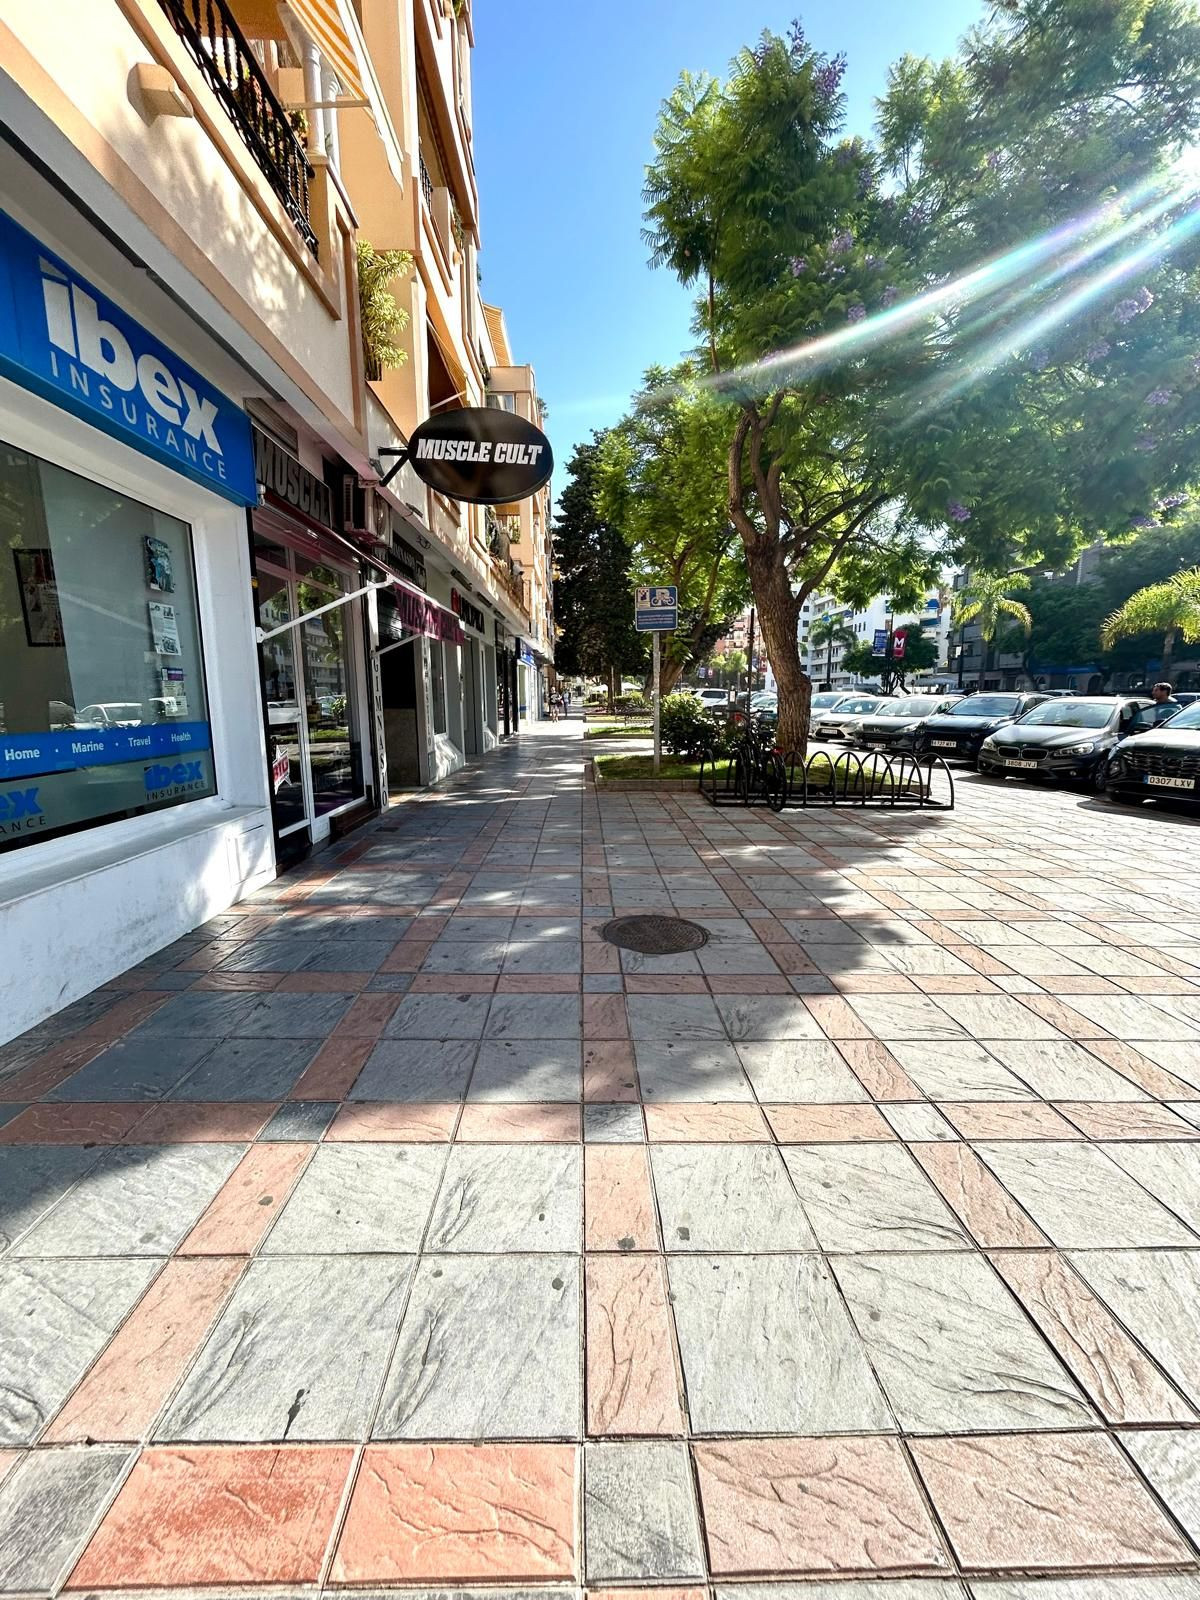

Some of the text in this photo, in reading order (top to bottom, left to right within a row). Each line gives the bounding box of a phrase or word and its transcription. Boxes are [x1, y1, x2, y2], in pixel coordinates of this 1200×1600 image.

[39, 255, 223, 457] ibex
[50, 351, 227, 480] INSURANCE
[416, 438, 543, 465] MUSCLE CULT
[256, 430, 330, 527] MUSCLE
[5, 731, 192, 761] Home Marine Travel Health
[144, 759, 203, 791] ibex
[145, 780, 206, 801] INSURANCE
[1149, 776, 1192, 788] 0307 LXV
